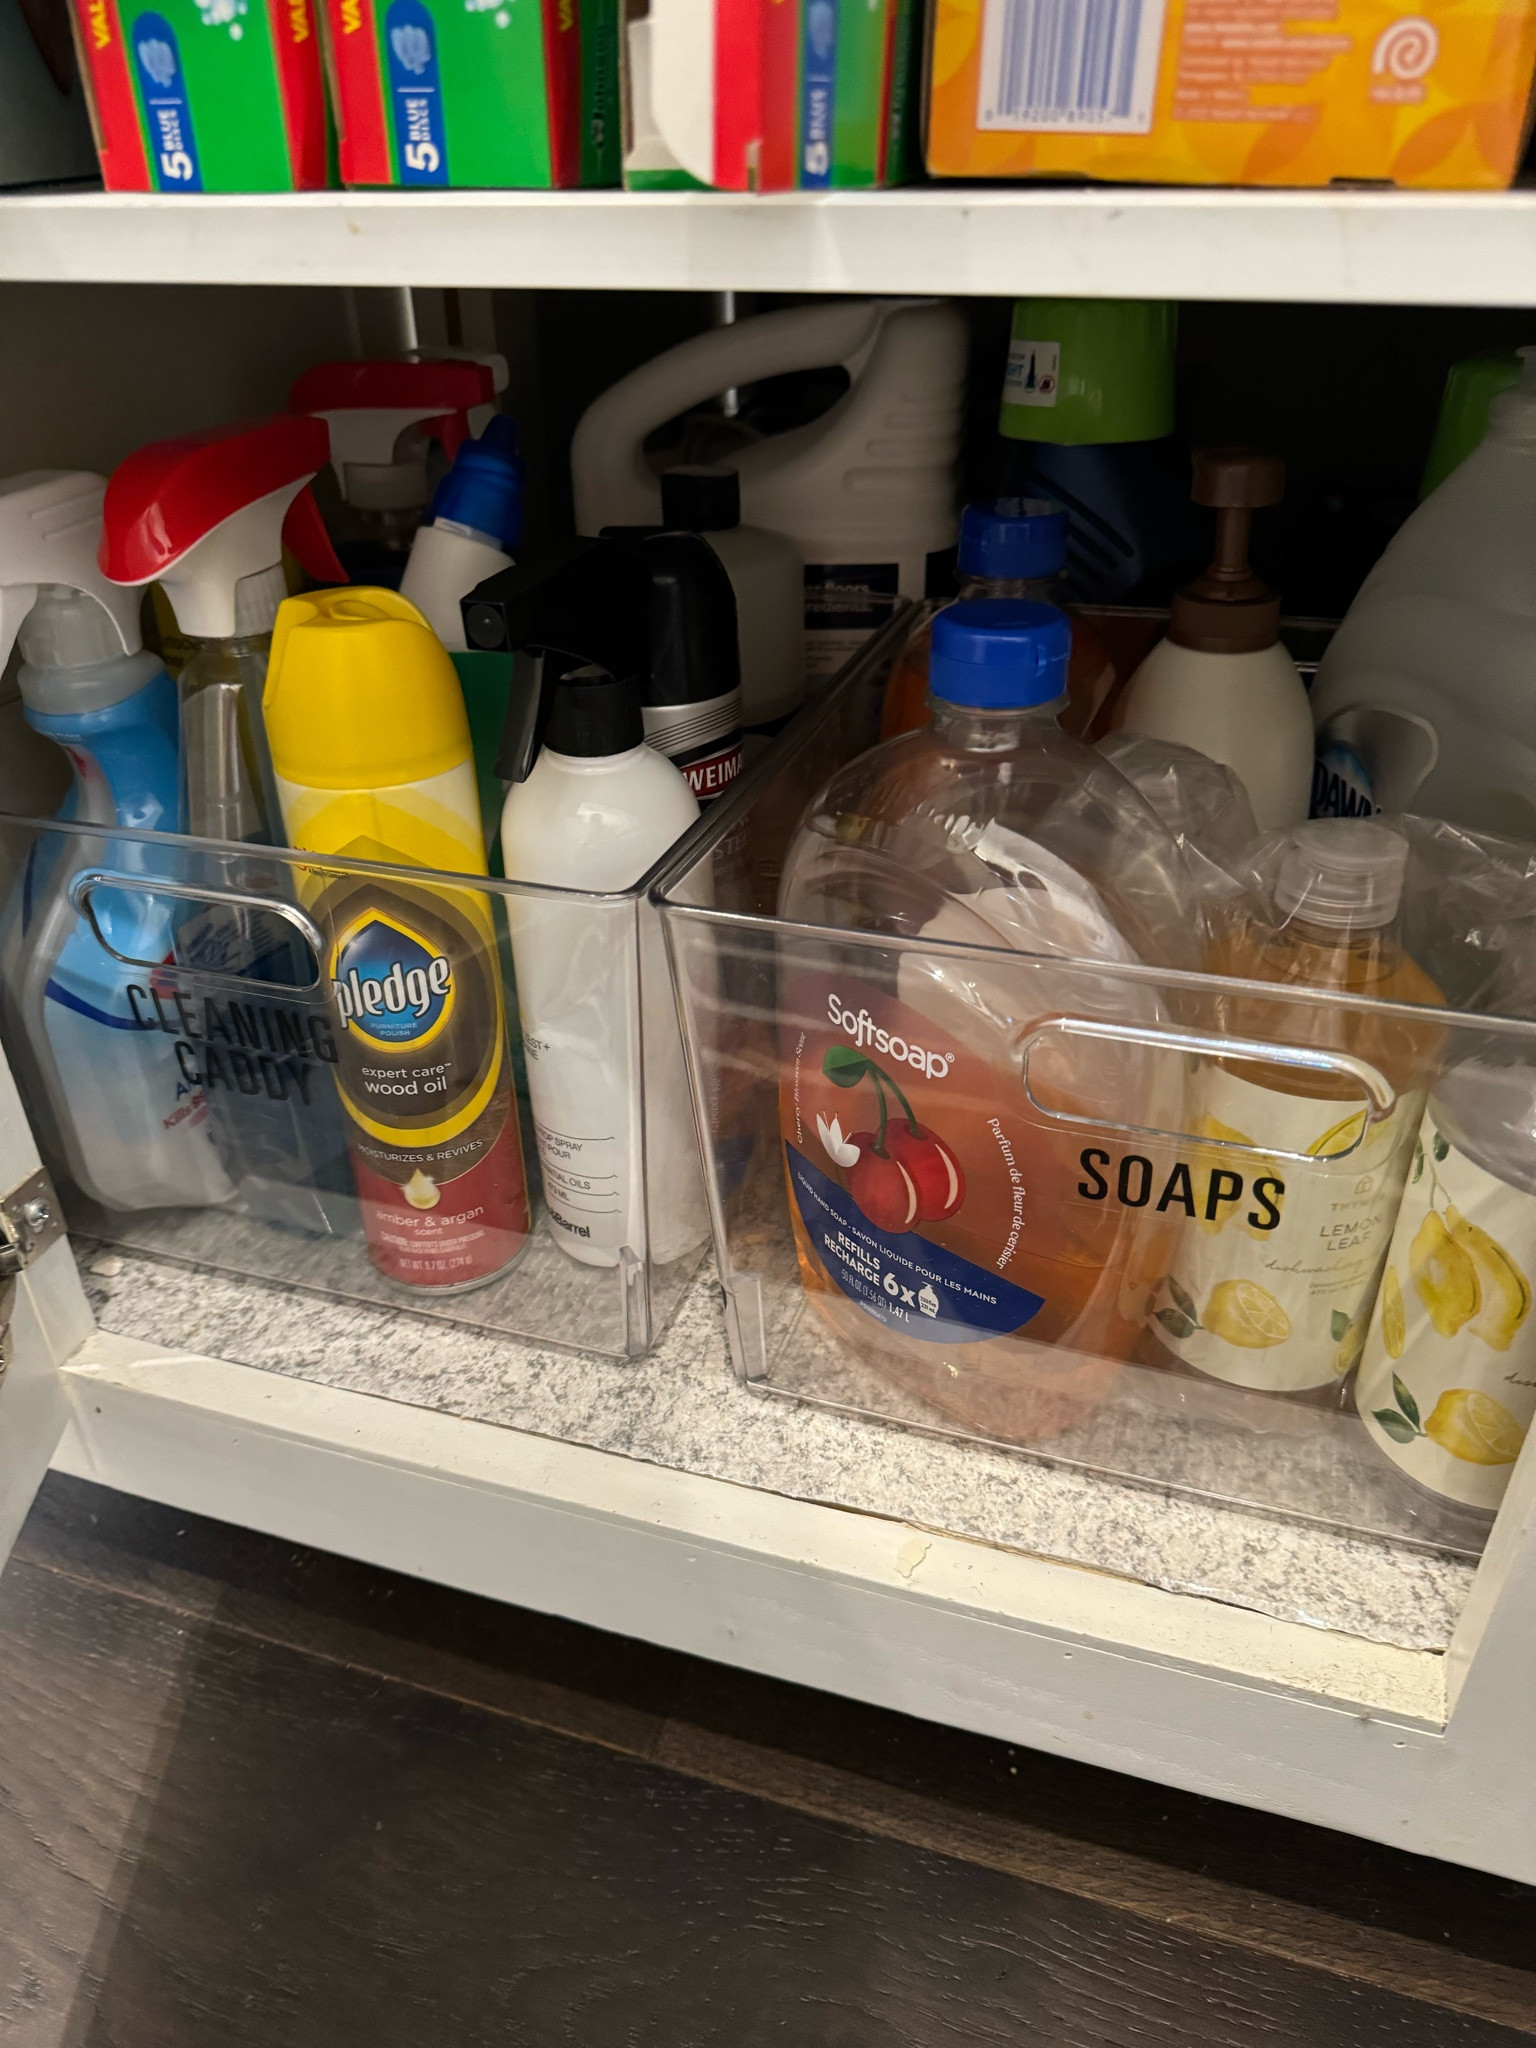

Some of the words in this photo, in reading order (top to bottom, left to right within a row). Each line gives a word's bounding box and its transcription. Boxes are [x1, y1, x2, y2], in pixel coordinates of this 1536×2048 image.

[157, 109, 174, 151] BLUE
[405, 98, 423, 141] BLUE
[160, 150, 193, 181] 5
[404, 142, 439, 173] 5
[332, 958, 451, 1028] pledge
[127, 984, 338, 1063] CLEANING
[174, 1040, 311, 1106] CADDY
[362, 1067, 408, 1080] expert
[365, 1081, 418, 1096] wood
[424, 1076, 447, 1093] oil
[358, 1143, 423, 1163] MOISTURIZES
[426, 1153, 434, 1161] &
[437, 1139, 483, 1159] REVIVES
[547, 1144, 571, 1159] POUR
[554, 1137, 582, 1151] SPRAY
[987, 1118, 1015, 1166] Parfum
[569, 1178, 591, 1190] OILS
[1009, 1168, 1022, 1183] de
[1078, 1148, 1285, 1231] SOAPS
[1013, 1186, 1026, 1215] fleur
[376, 1210, 419, 1227] amber
[424, 1216, 436, 1226] &
[441, 1206, 484, 1225] argan
[414, 1227, 444, 1236] scent
[1012, 1215, 1026, 1231] de
[1319, 1215, 1381, 1238] LEMON
[797, 1172, 814, 1194] LIQUID
[813, 1191, 829, 1211] HAND
[830, 1208, 847, 1226] SOAP
[852, 1226, 878, 1249] SAVON
[879, 1246, 913, 1270] LIQUIDE
[915, 1265, 942, 1283] POUR
[944, 1279, 961, 1292] LES
[963, 1288, 997, 1305] MAINS
[838, 1231, 881, 1271] REFILLS
[996, 1231, 1019, 1270] cerisier
[1327, 1230, 1371, 1251] LEAF
[824, 1233, 880, 1286] RECHARGE
[883, 1272, 916, 1308] 6x
[889, 1301, 904, 1318] 1.47
[905, 1311, 910, 1323] L
